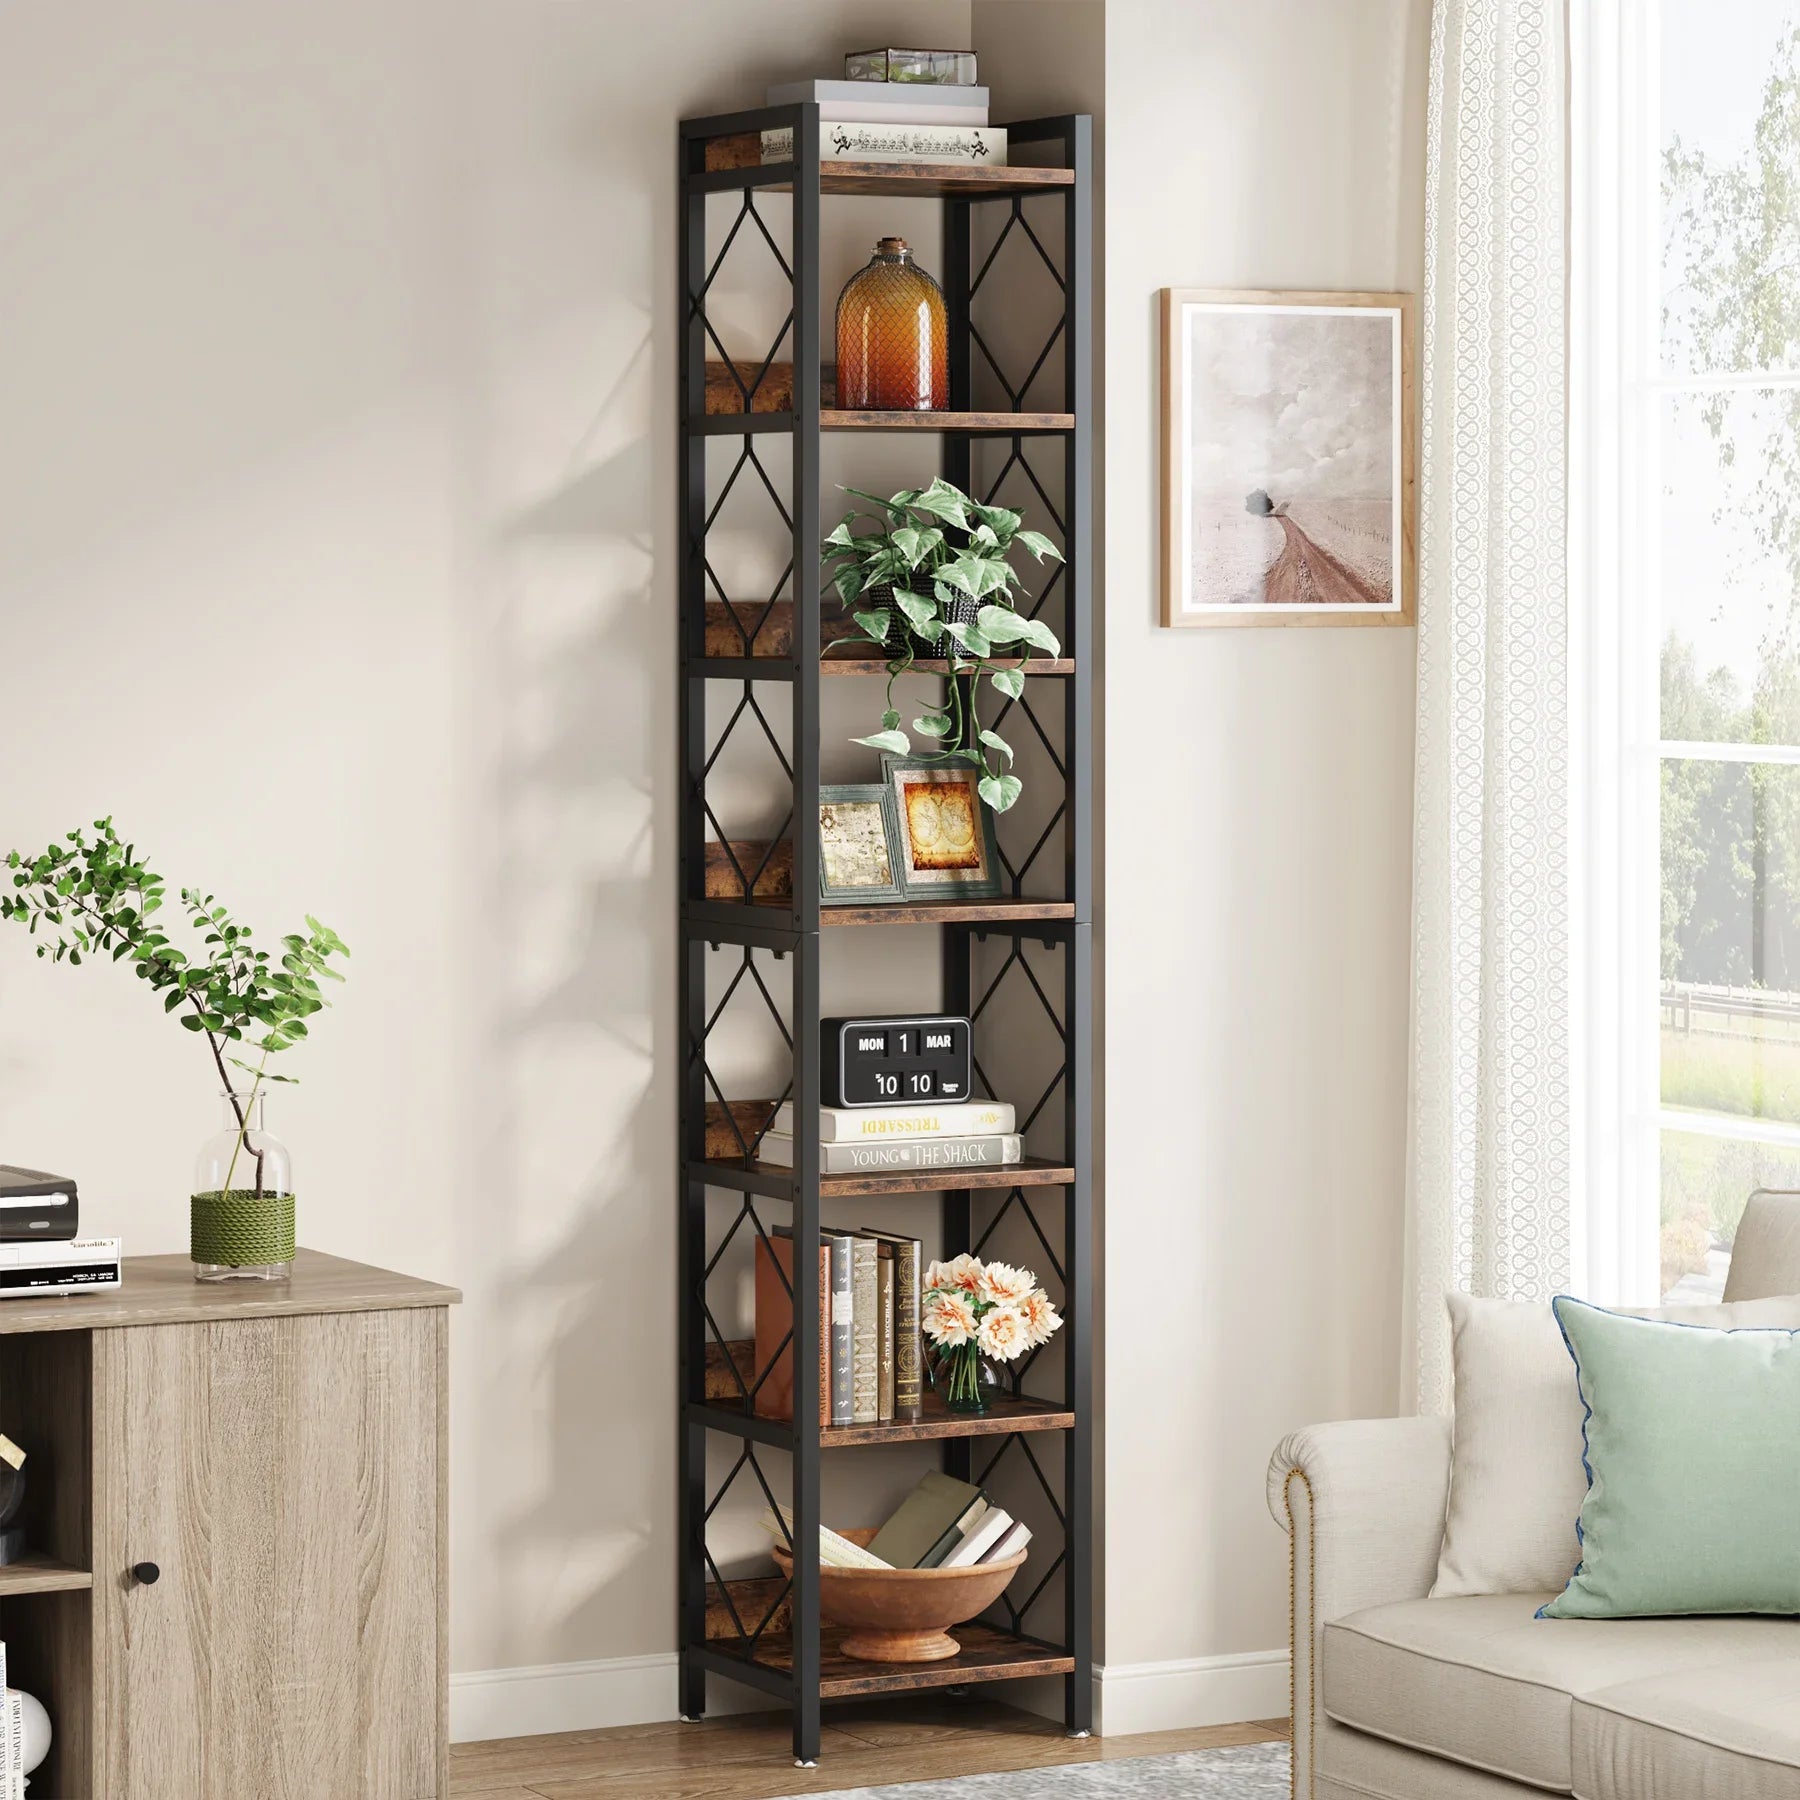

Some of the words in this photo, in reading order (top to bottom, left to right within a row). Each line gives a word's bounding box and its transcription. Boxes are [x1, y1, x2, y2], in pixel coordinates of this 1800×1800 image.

[859, 1038, 884, 1051] MON
[899, 1033, 907, 1053] 1
[926, 1035, 952, 1049] MAR
[877, 1076, 898, 1095] 10
[910, 1074, 931, 1093] 10
[862, 1116, 940, 1134] TRUSSARDI
[850, 1149, 899, 1166] YOUNG
[912, 1145, 940, 1165] THE
[943, 1143, 987, 1164] SHACK
